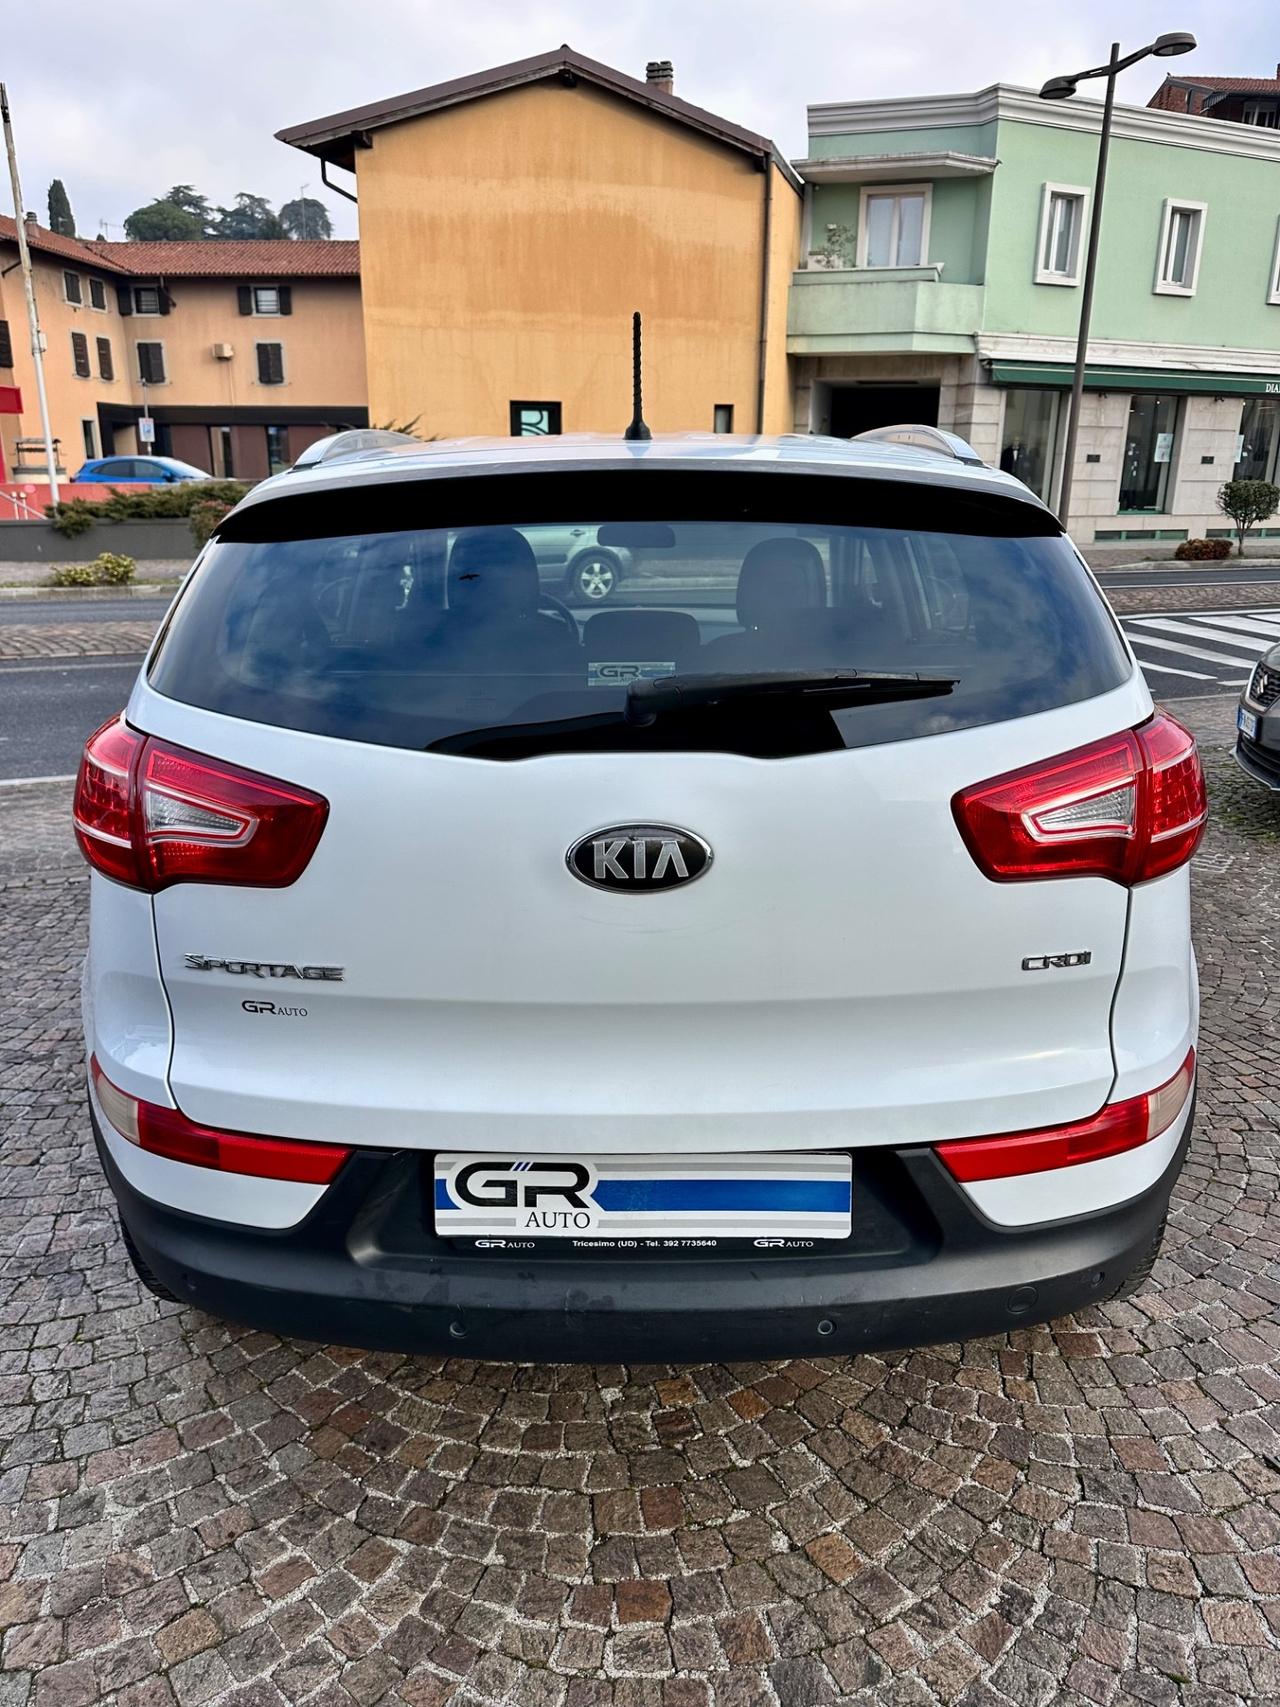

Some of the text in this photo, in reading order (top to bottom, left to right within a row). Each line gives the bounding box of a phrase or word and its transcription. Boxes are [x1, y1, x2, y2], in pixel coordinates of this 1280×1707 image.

[599, 665, 640, 678] GR
[592, 840, 689, 879] KIA
[184, 953, 345, 982] SPORTAGE
[241, 1000, 308, 1017] GR AUTO
[455, 1161, 590, 1209] GR
[524, 1211, 591, 1229] AUTO
[474, 1239, 536, 1249] GR AUTO
[617, 1240, 638, 1248] (UD)
[753, 1239, 815, 1248] GR AUTO
